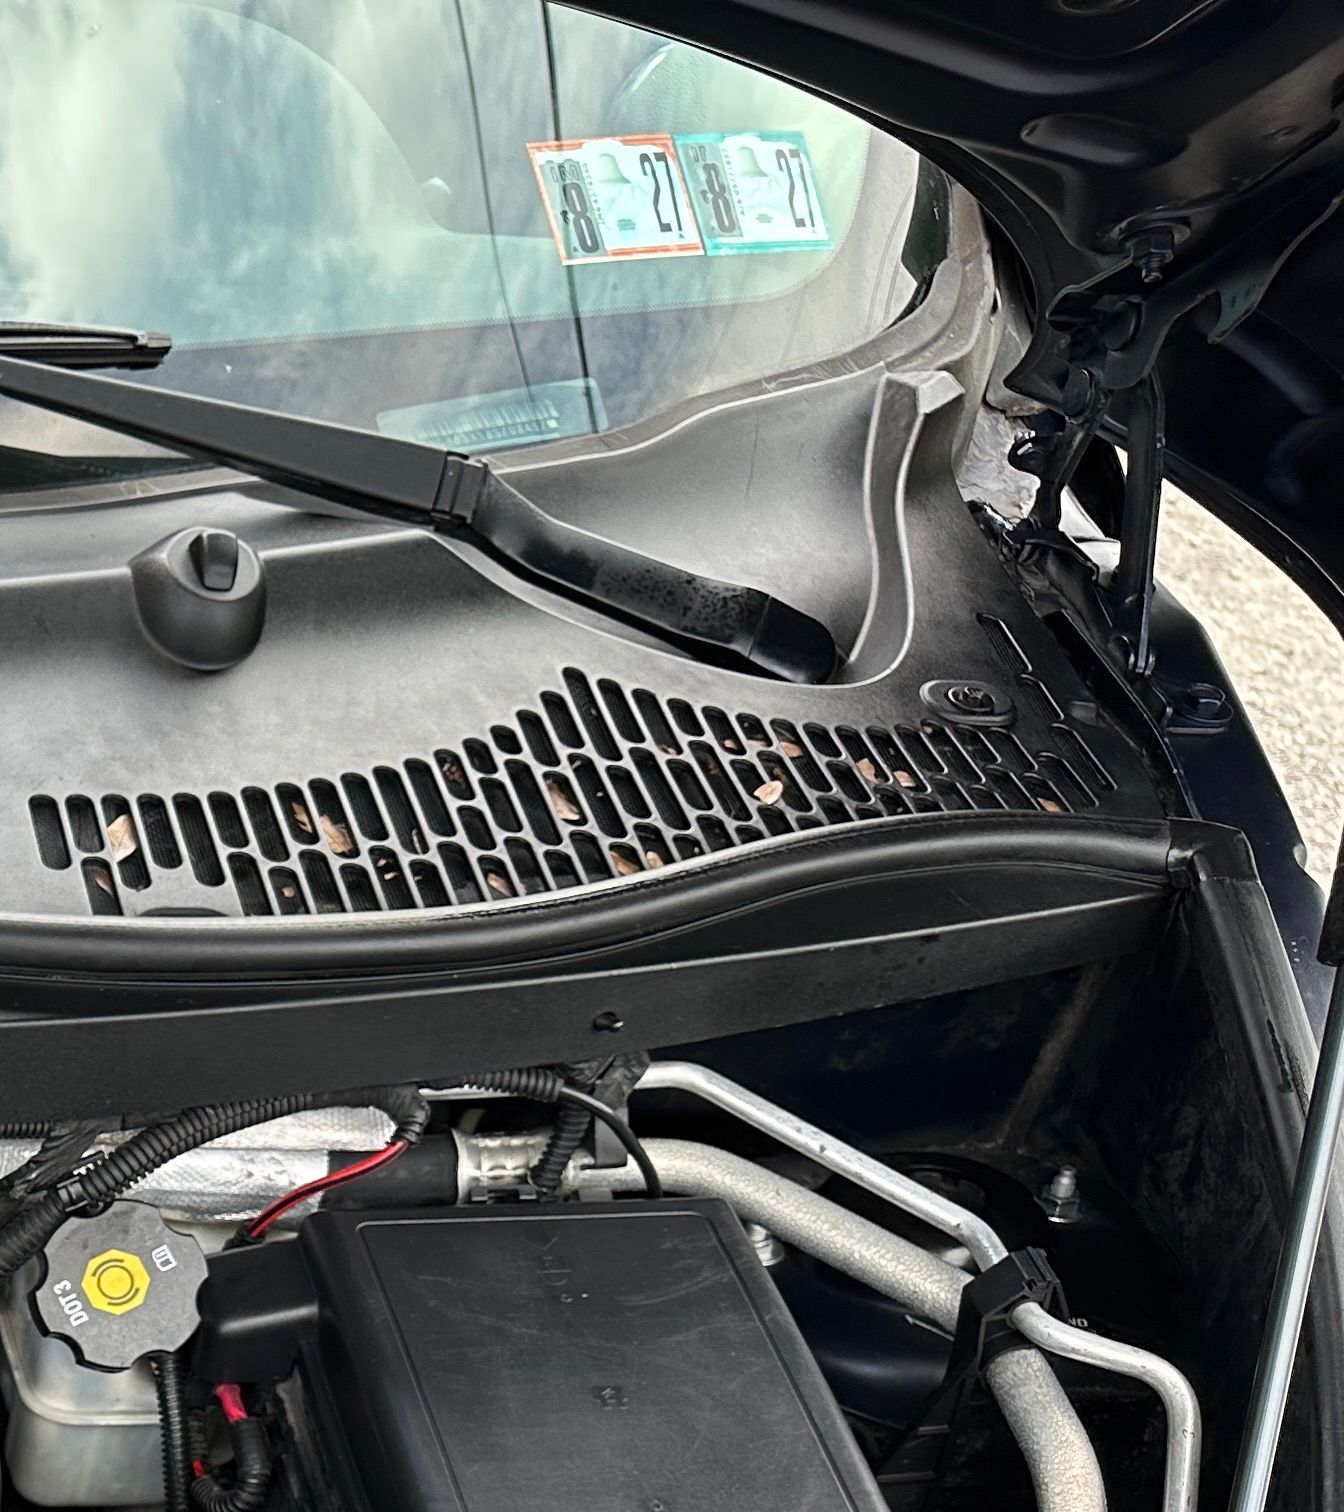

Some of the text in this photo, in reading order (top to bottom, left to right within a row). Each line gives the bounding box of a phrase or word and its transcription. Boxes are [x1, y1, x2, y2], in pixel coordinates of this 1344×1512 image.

[563, 182, 599, 253] 8
[639, 151, 683, 233] 27
[703, 163, 736, 233] 8
[775, 148, 815, 228] 27
[53, 1279, 89, 1327] DOT 3
